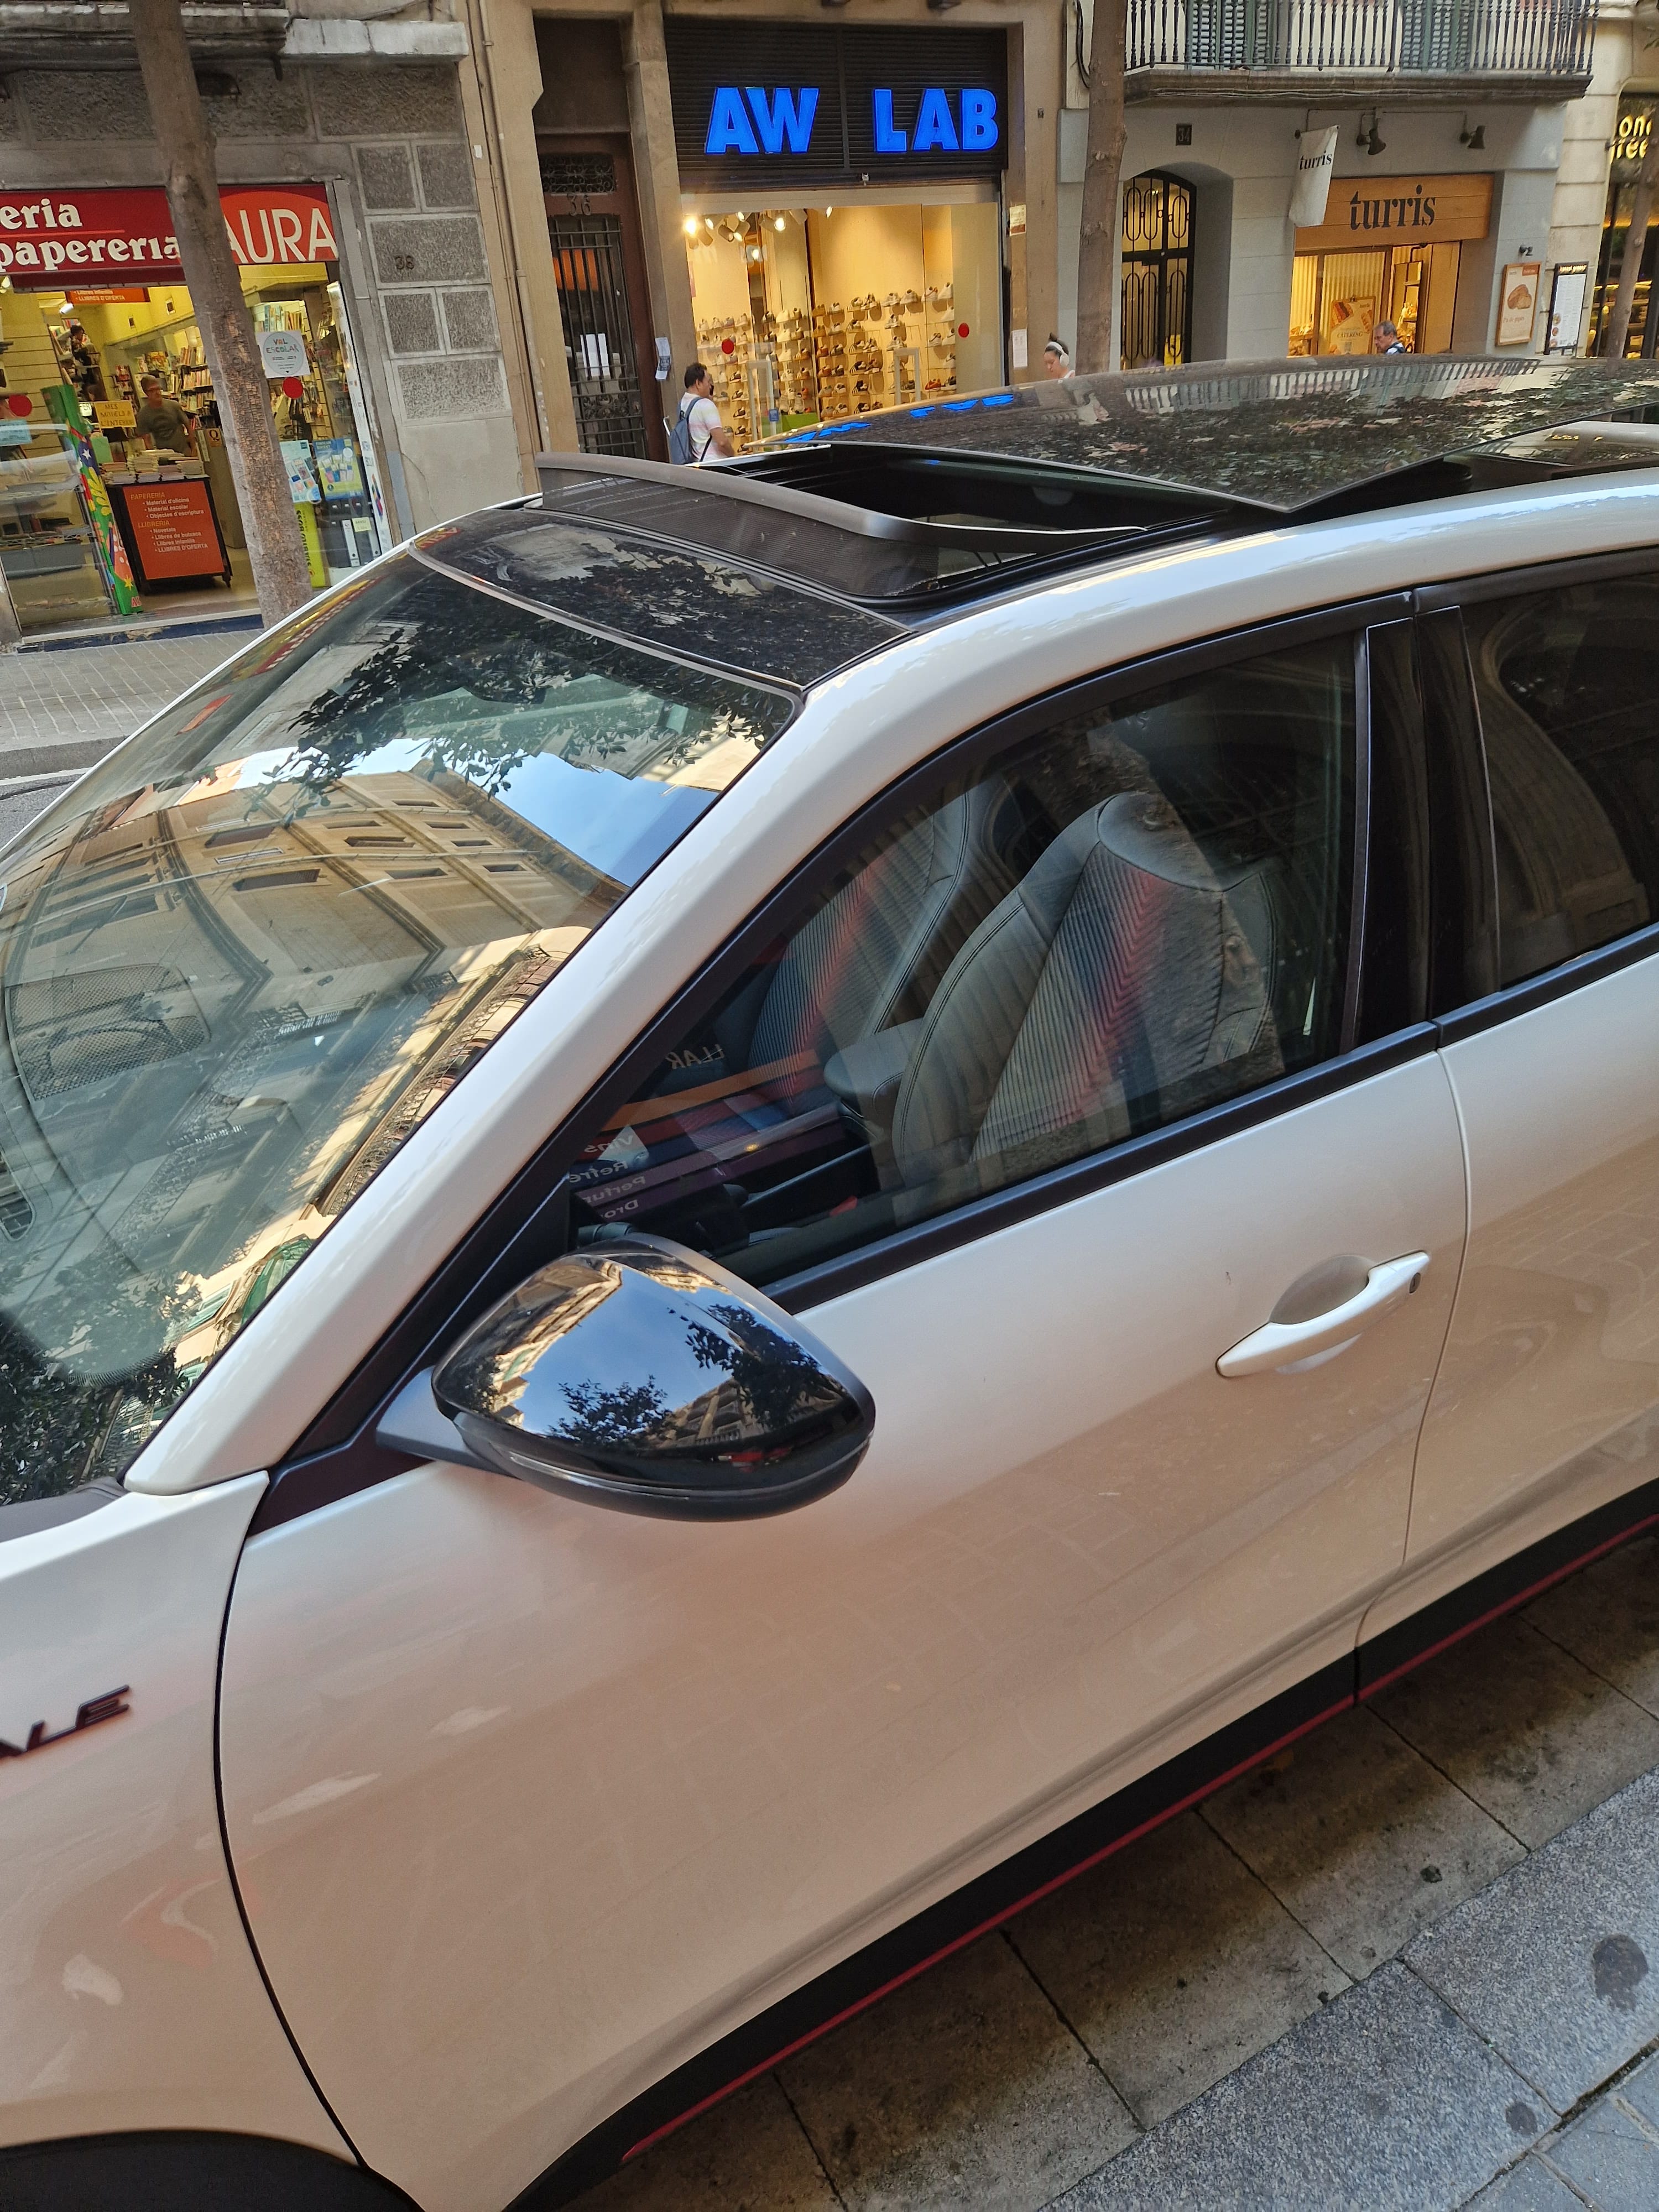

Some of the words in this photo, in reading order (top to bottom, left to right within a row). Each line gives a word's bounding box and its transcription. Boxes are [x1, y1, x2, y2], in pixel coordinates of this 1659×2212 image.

[705, 86, 820, 154] AW
[874, 88, 999, 153] LAB
[1300, 150, 1332, 170] turris
[0, 198, 82, 229] eria
[567, 193, 591, 216] 36
[1350, 185, 1436, 230] turris
[138, 520, 170, 528] LLIBRERIA
